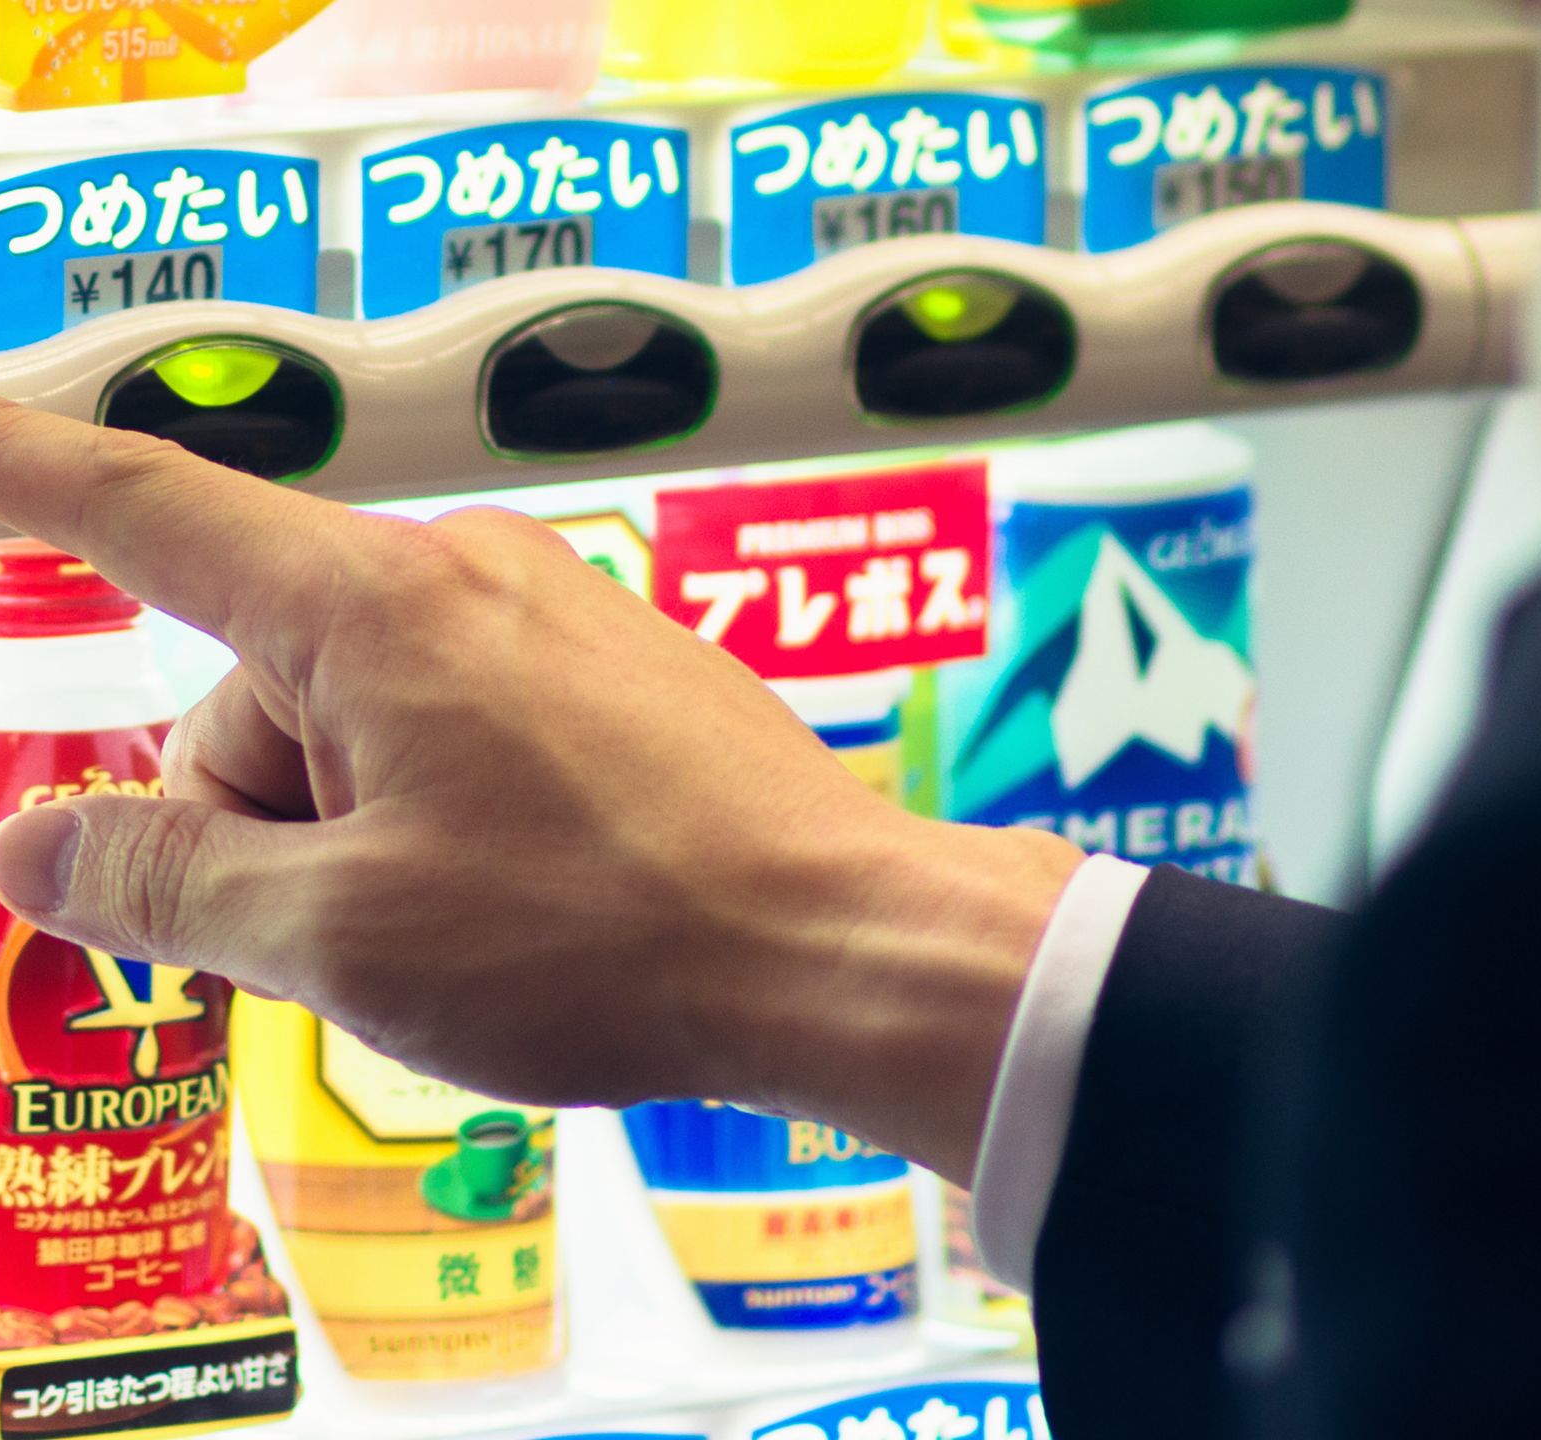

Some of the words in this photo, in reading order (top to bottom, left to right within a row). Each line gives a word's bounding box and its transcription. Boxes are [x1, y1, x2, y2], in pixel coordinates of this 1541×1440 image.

[735, 104, 1039, 195] つめたい
[1090, 76, 1380, 167] つめたい
[368, 136, 681, 224] つめたい
[71, 250, 216, 316] ¥140
[447, 220, 586, 283] ¥170
[12, 1062, 232, 1134] EUROPEAN
[83, 1258, 183, 1292] コーヒー
